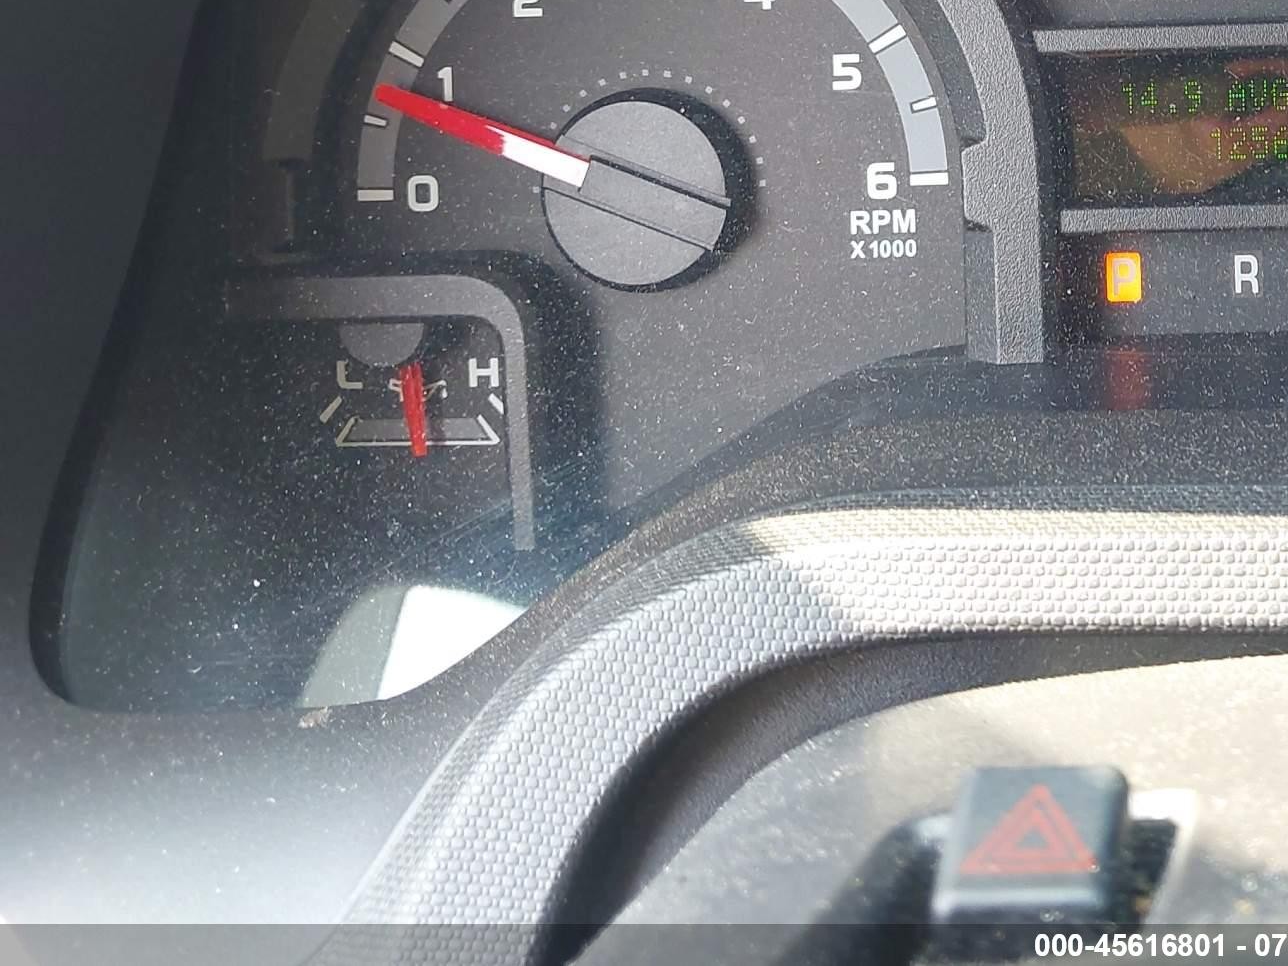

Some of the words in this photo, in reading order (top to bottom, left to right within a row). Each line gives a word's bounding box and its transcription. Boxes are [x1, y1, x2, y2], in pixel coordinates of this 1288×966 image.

[436, 66, 453, 102] 1
[832, 53, 862, 91] 5
[1228, 80, 1288, 112] AVG
[407, 175, 439, 212] 0
[866, 162, 898, 200] 6
[850, 209, 916, 235] RPM
[1112, 258, 1136, 296] P
[1234, 254, 1259, 294] R
[336, 359, 364, 390] L
[468, 357, 500, 388] H
